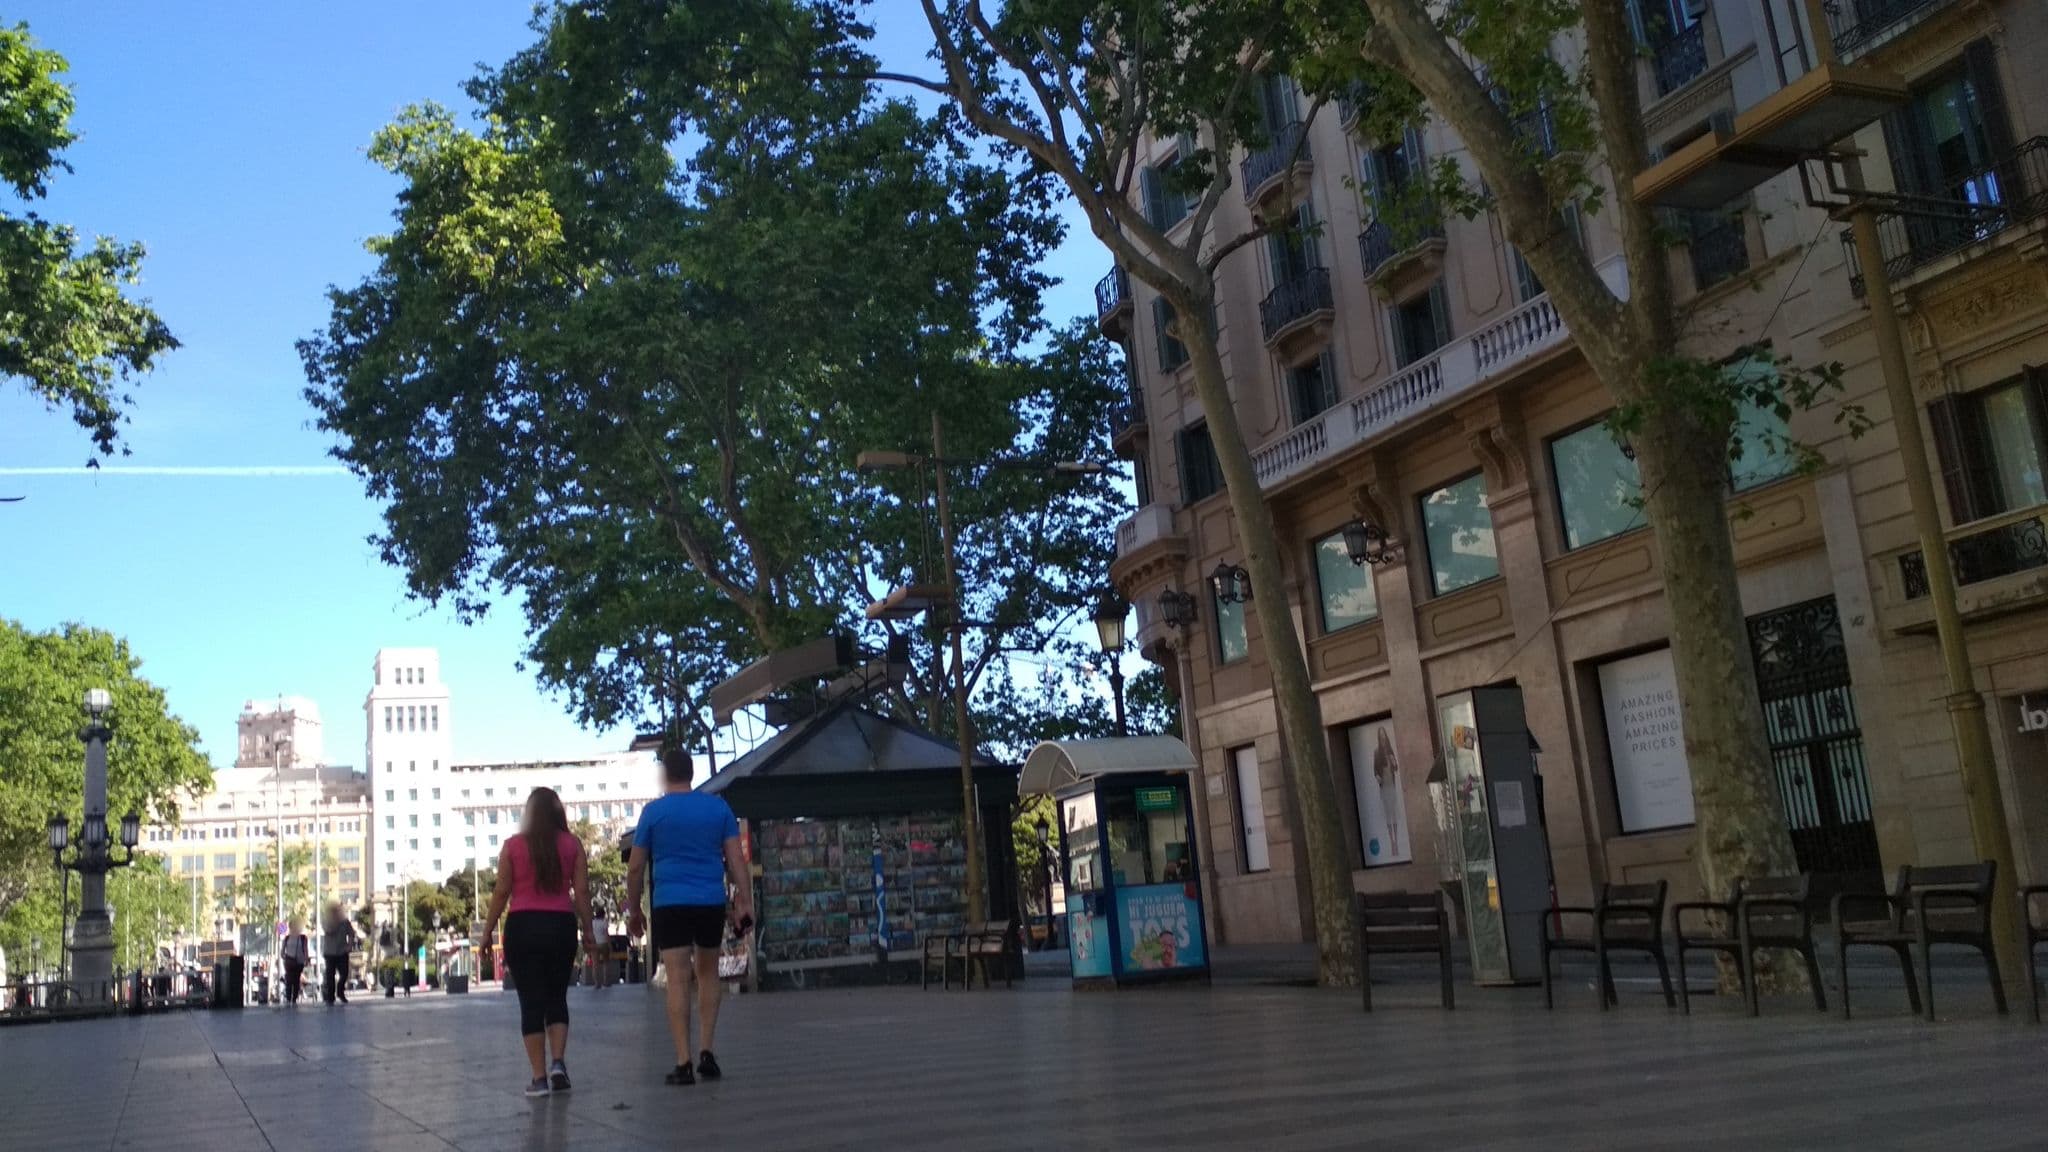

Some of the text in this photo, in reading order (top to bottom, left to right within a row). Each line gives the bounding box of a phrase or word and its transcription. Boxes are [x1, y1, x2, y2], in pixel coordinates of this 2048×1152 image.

[1621, 689, 1674, 711] AMAZING
[1624, 705, 1676, 725] FASHION
[1625, 719, 1679, 740] AMAZING
[1632, 736, 1677, 752] PRICES
